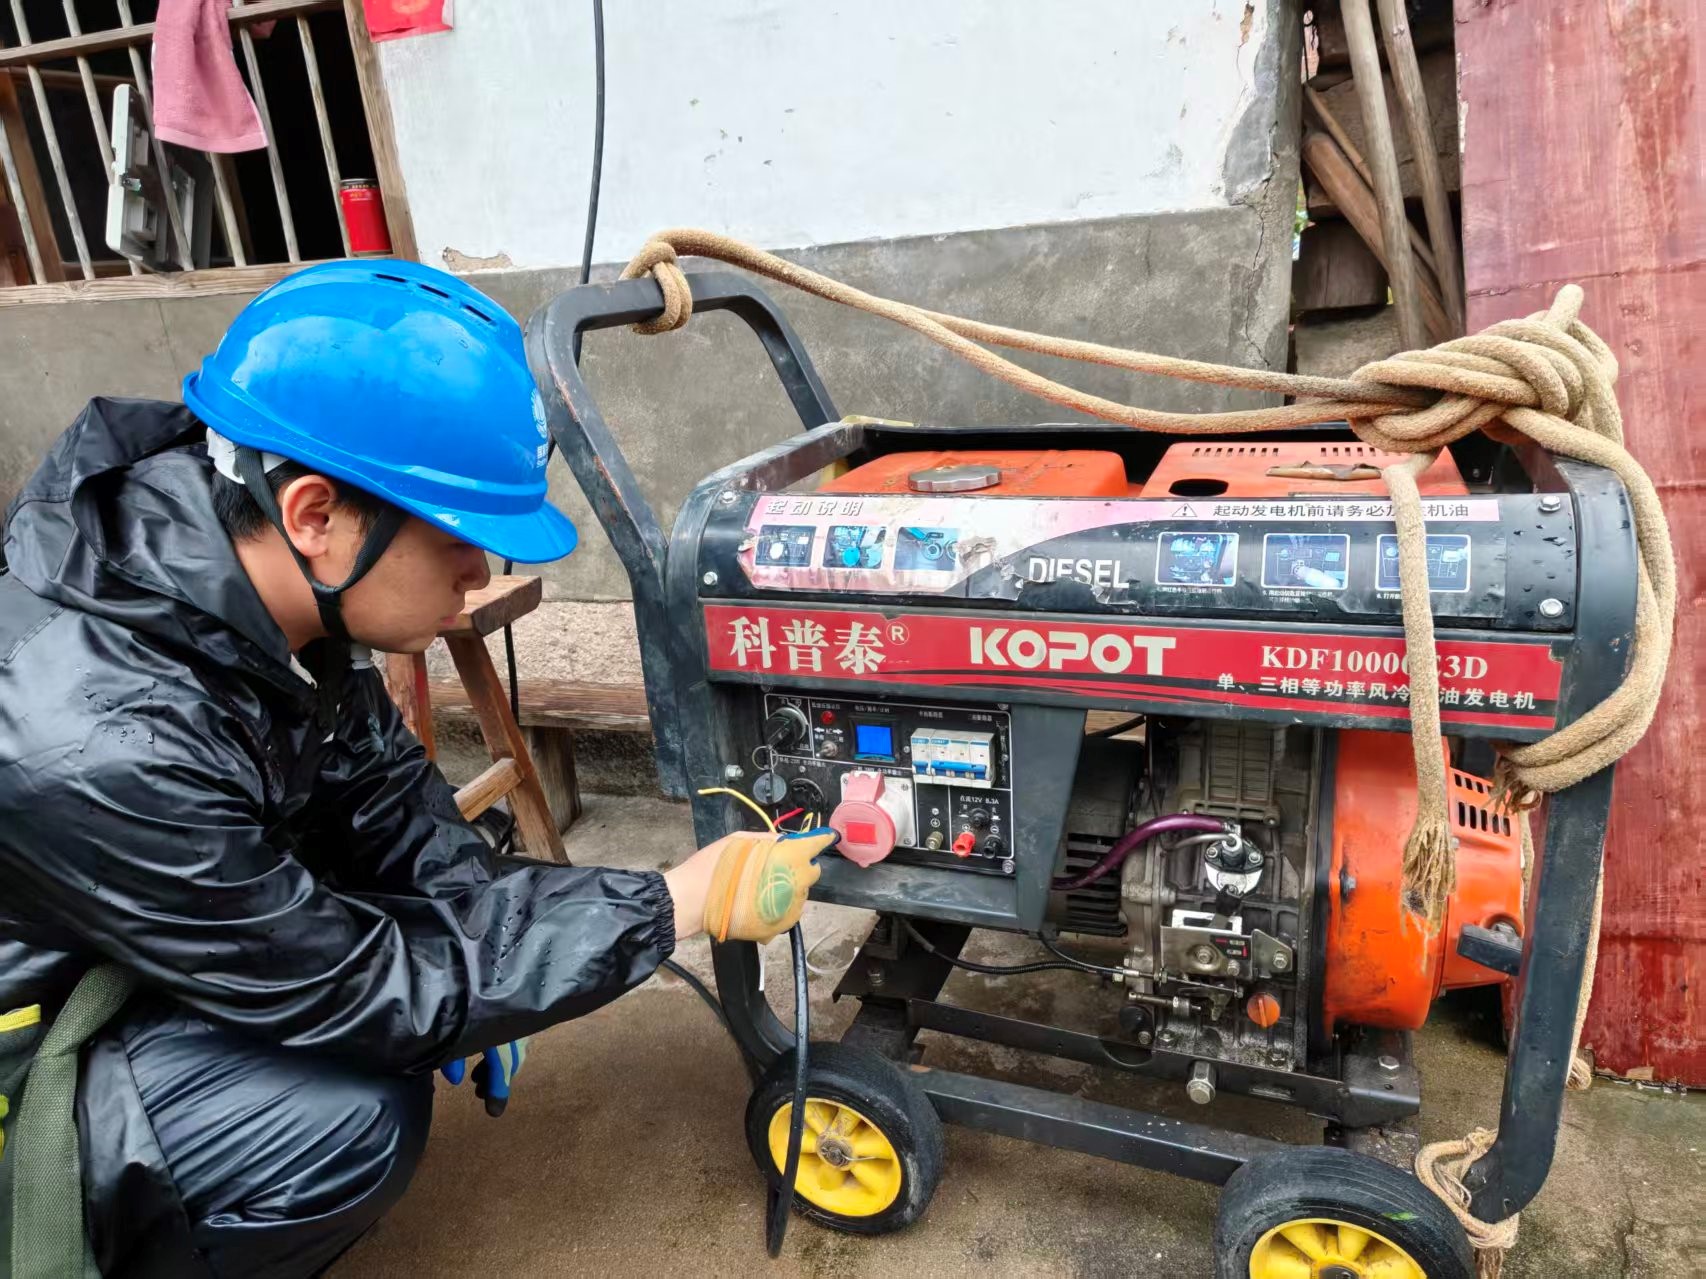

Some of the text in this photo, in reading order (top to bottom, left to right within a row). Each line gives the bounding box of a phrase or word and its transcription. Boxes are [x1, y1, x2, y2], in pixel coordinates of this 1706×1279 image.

[765, 499, 864, 516] 起动说明
[1213, 503, 1469, 518] 起动发电机前请务必机油
[1029, 557, 1130, 588] DIESEL
[728, 615, 887, 674] 科普泰
[969, 626, 1177, 677] KOPOT
[1260, 644, 1489, 680] KDF10003D
[1217, 672, 1536, 710] 单、三相等功率风冷油发电机
